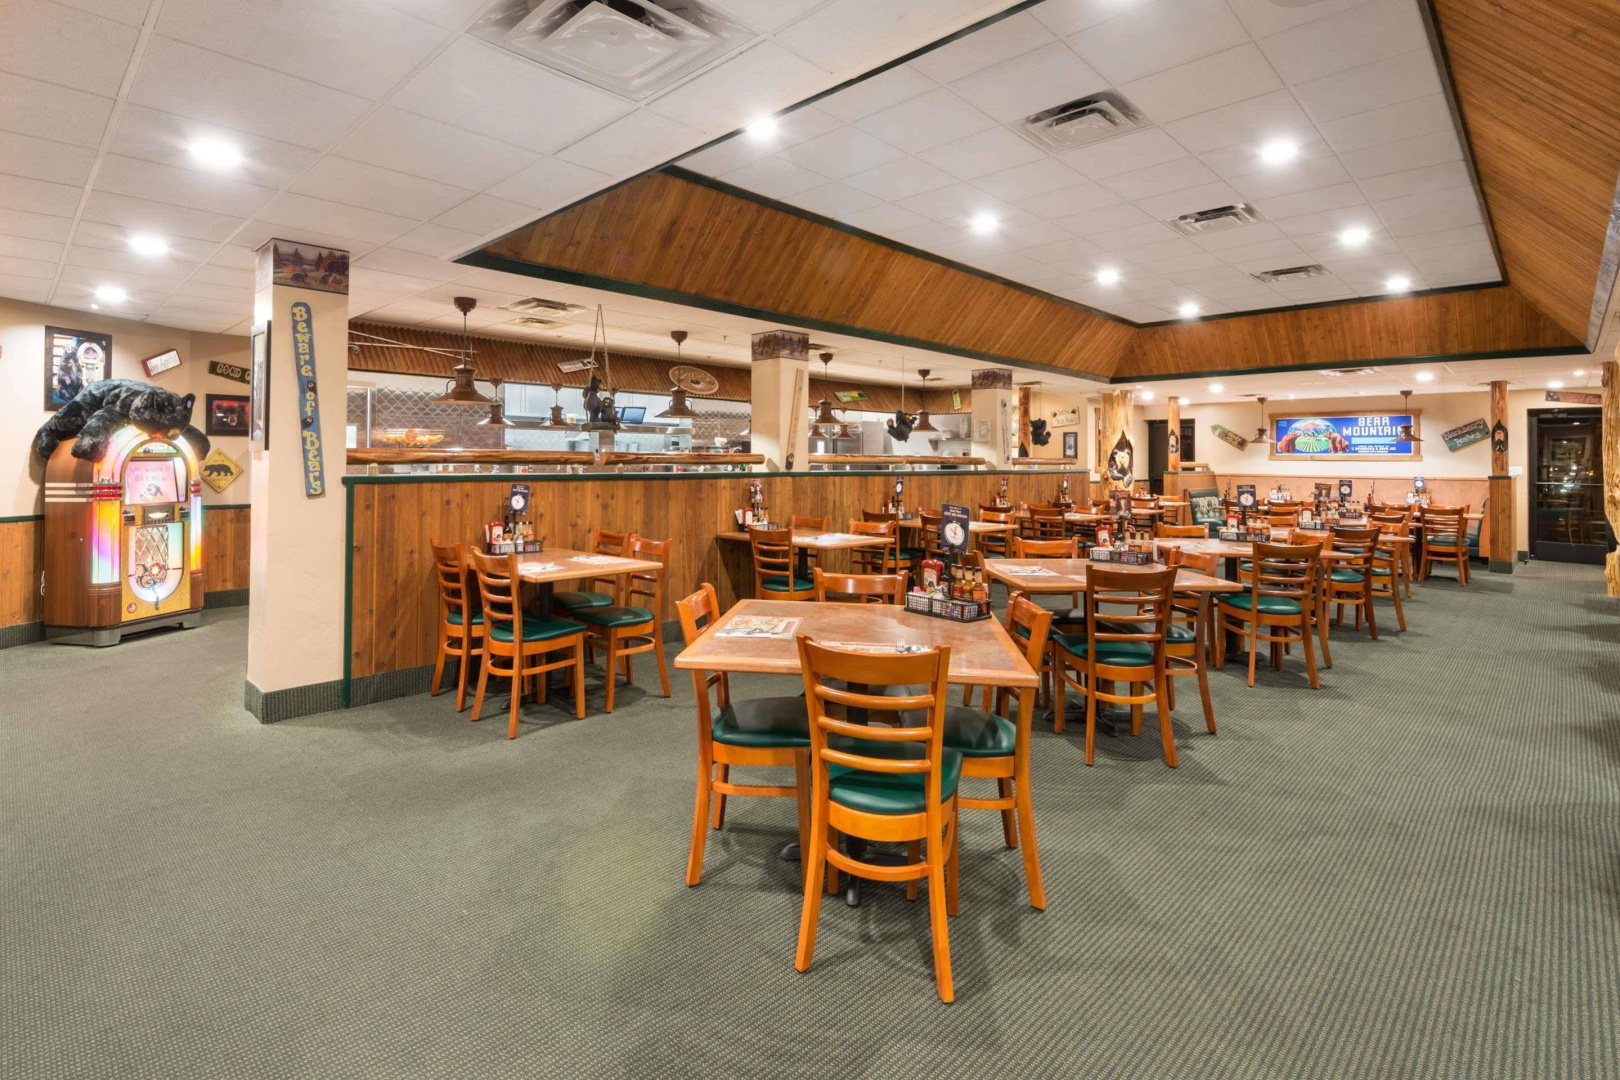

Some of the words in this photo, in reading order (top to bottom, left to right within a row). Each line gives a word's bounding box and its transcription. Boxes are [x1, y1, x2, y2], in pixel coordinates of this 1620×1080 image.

[292, 306, 313, 377] Beware
[216, 363, 242, 378] GOOD
[305, 391, 315, 416] of
[1358, 416, 1390, 427] BEAR
[302, 430, 322, 494] Bears
